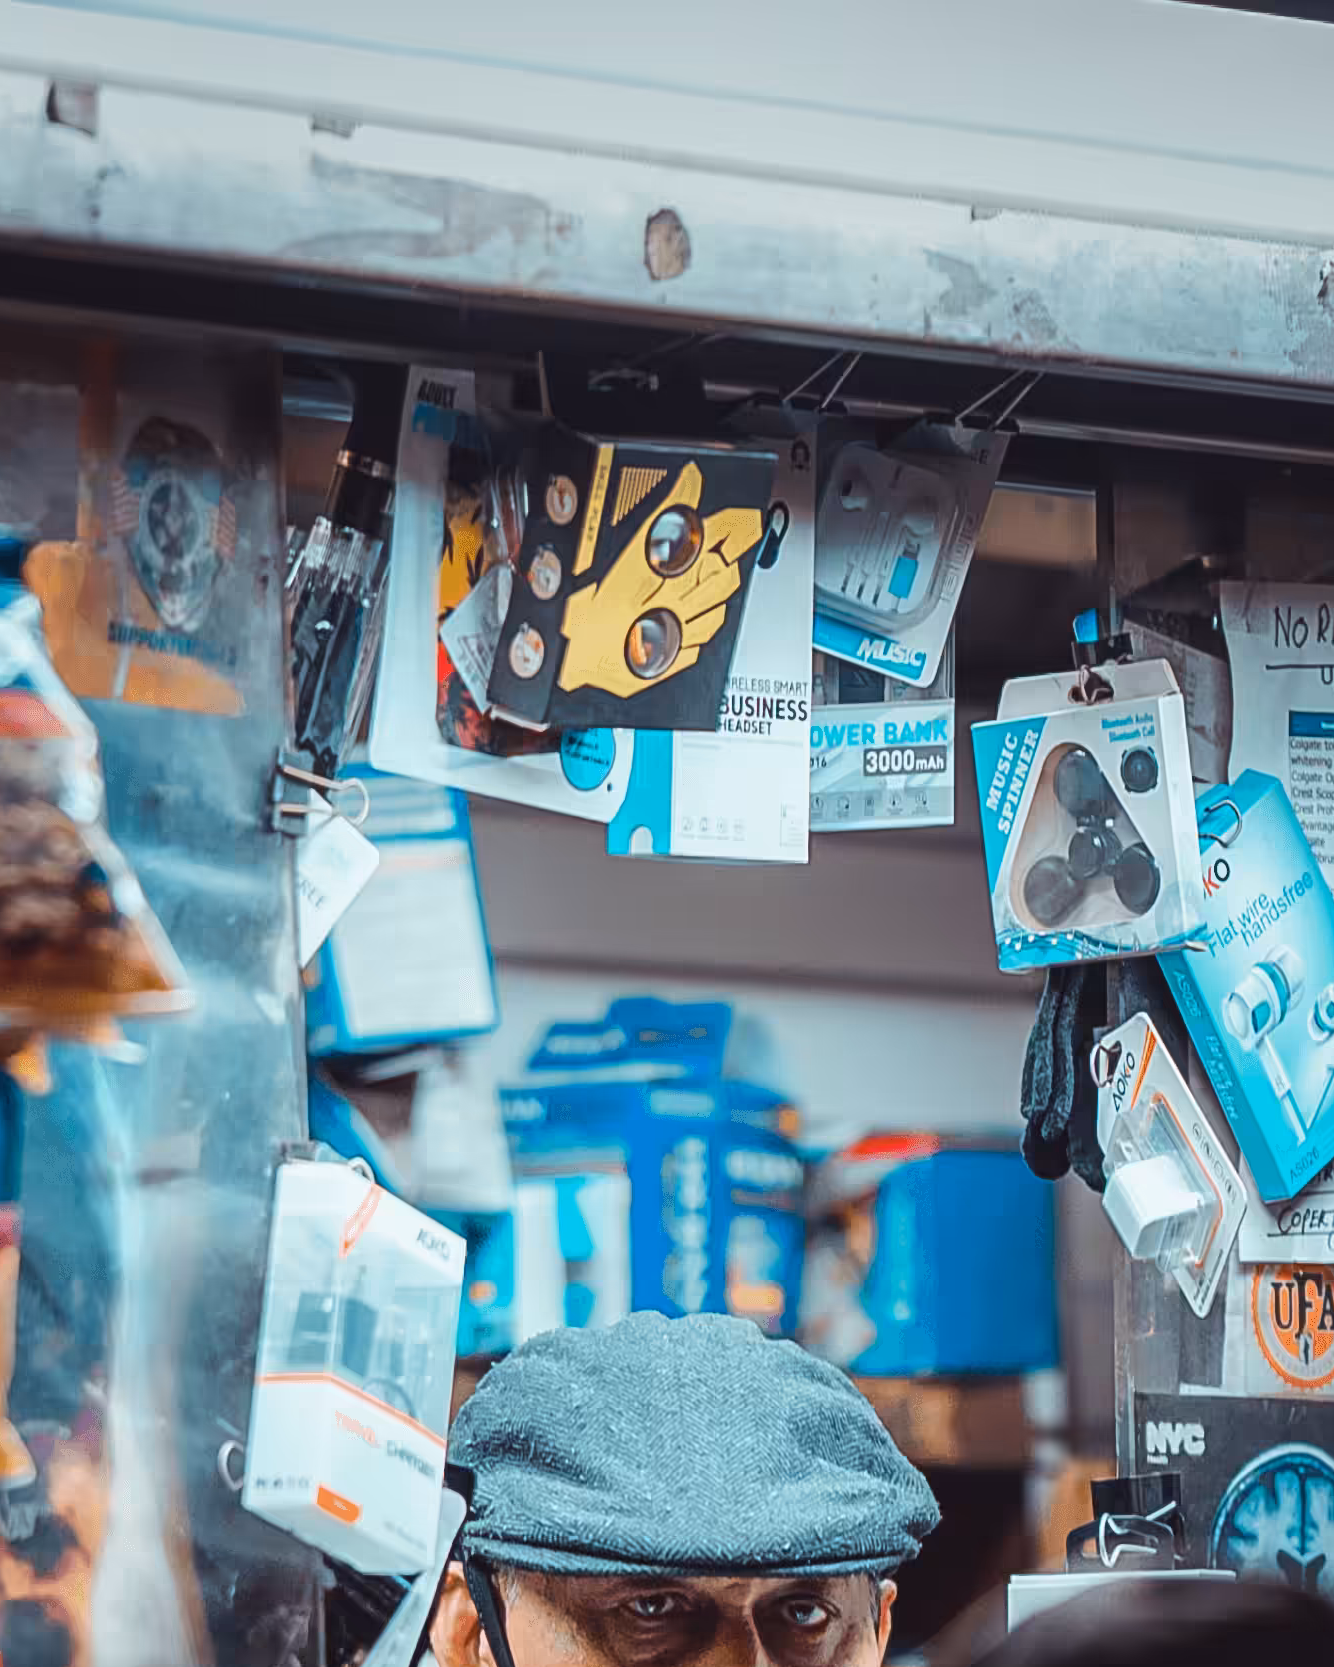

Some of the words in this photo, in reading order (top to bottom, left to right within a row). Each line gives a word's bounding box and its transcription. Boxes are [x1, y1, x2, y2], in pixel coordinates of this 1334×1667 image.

[1274, 604, 1309, 649] NO
[857, 637, 927, 667] MUSIC
[774, 680, 808, 696] SMART
[720, 696, 808, 722] BUSINESS
[720, 718, 772, 736] HEADSET
[810, 723, 876, 749] OWER
[884, 719, 948, 745] BANK
[985, 732, 1018, 812] MUSIC
[997, 728, 1039, 835] SPINNER
[1291, 771, 1323, 785] Colgate
[1207, 922, 1239, 958] Flat
[1238, 891, 1268, 931] wire
[1242, 870, 1315, 949] handsfree
[1146, 1421, 1206, 1456] NYC
